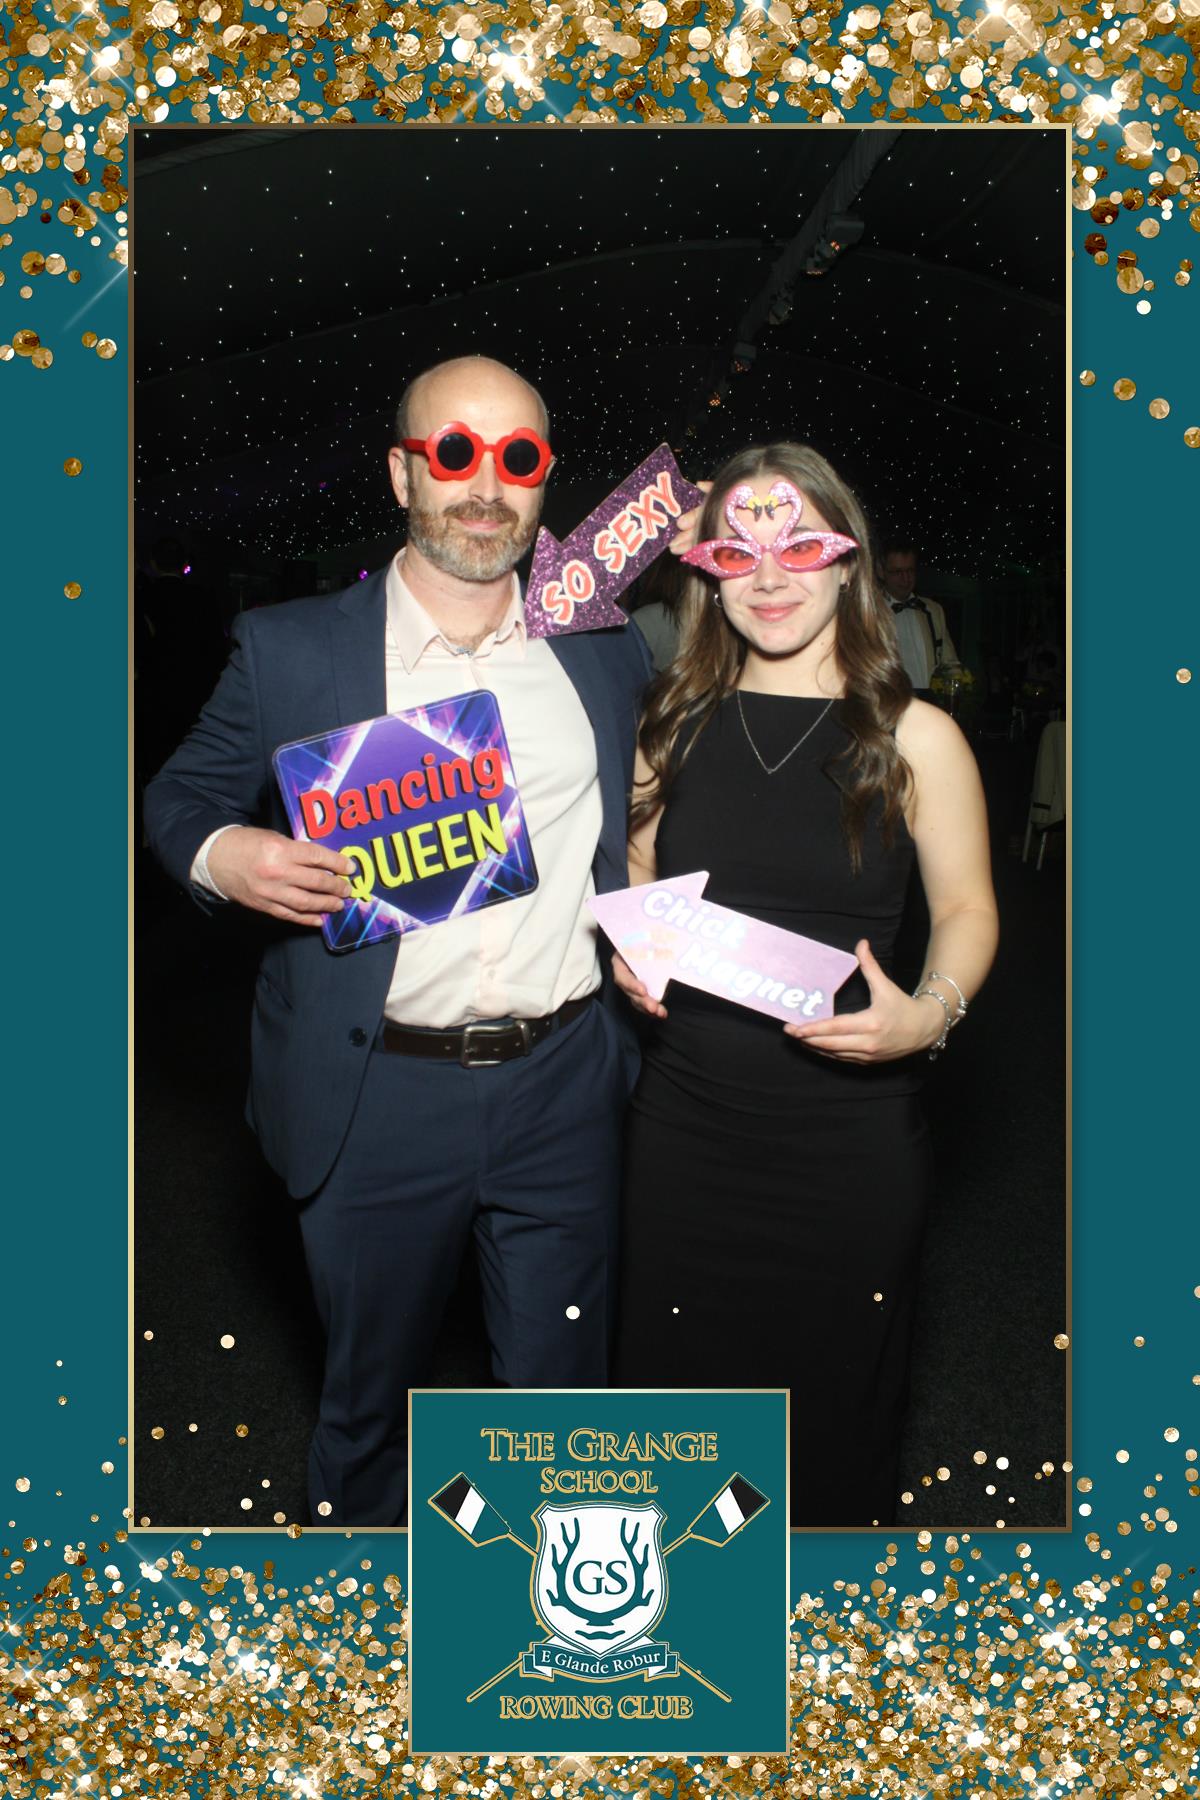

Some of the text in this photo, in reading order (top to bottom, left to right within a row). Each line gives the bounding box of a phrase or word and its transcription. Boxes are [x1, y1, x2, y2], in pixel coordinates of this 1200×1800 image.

[542, 471, 682, 625] SO SEXY
[299, 747, 506, 840] Dancing
[337, 802, 509, 902] QUEEN
[642, 888, 748, 948] Chick
[678, 942, 826, 1018] Magnet
